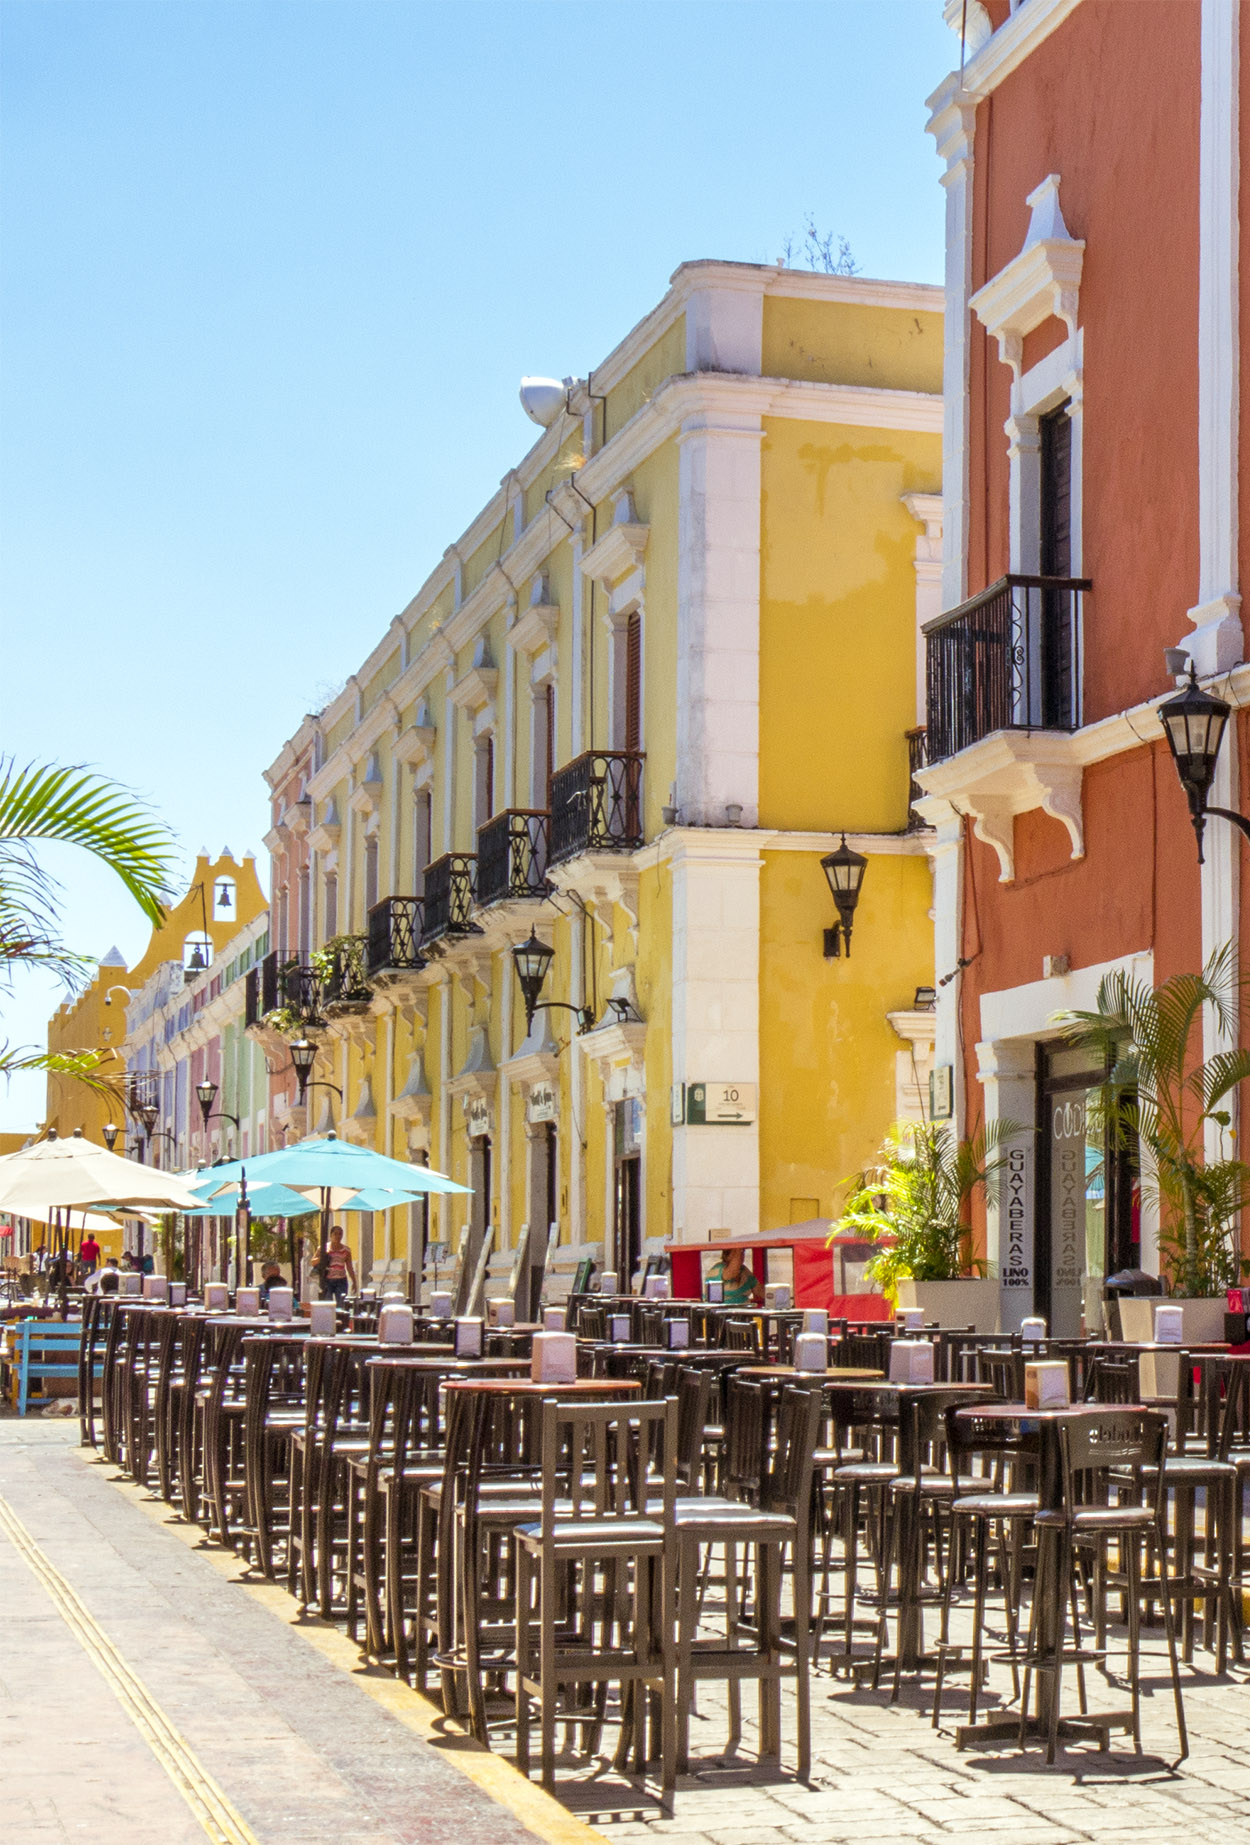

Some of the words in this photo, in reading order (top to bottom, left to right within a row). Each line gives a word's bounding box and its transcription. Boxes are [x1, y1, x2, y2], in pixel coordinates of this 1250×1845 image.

[723, 1089, 740, 1102] 10
[1009, 1149, 1025, 1266] GUAYABERAS
[1003, 1268, 1029, 1278] LINO
[1003, 1279, 1030, 1287] 100%
